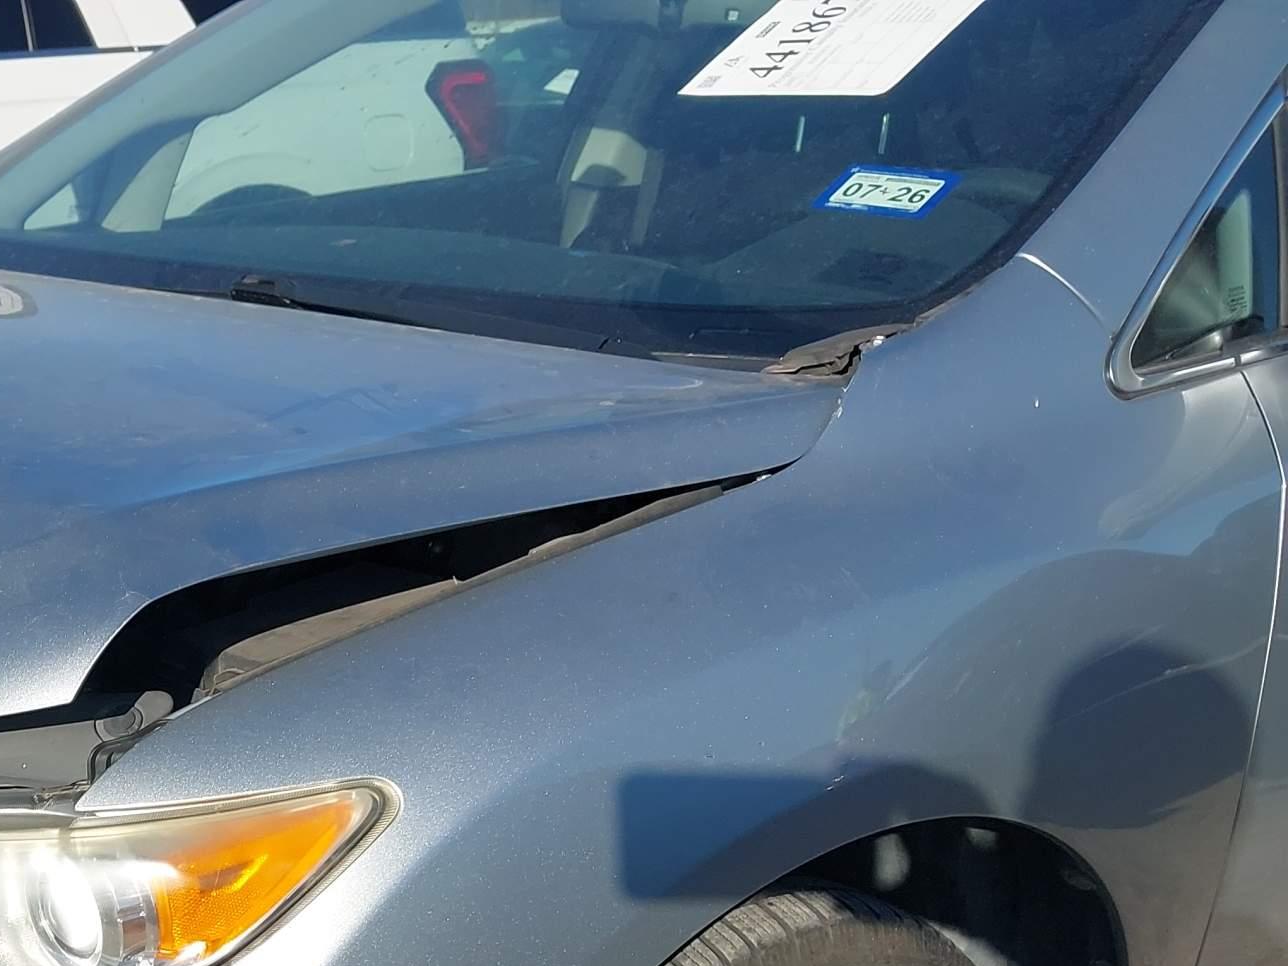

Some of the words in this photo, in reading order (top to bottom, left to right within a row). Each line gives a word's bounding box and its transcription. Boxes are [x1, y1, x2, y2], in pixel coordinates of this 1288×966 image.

[749, 0, 847, 78] 44186
[842, 182, 881, 199] 07
[888, 186, 930, 204] 26
